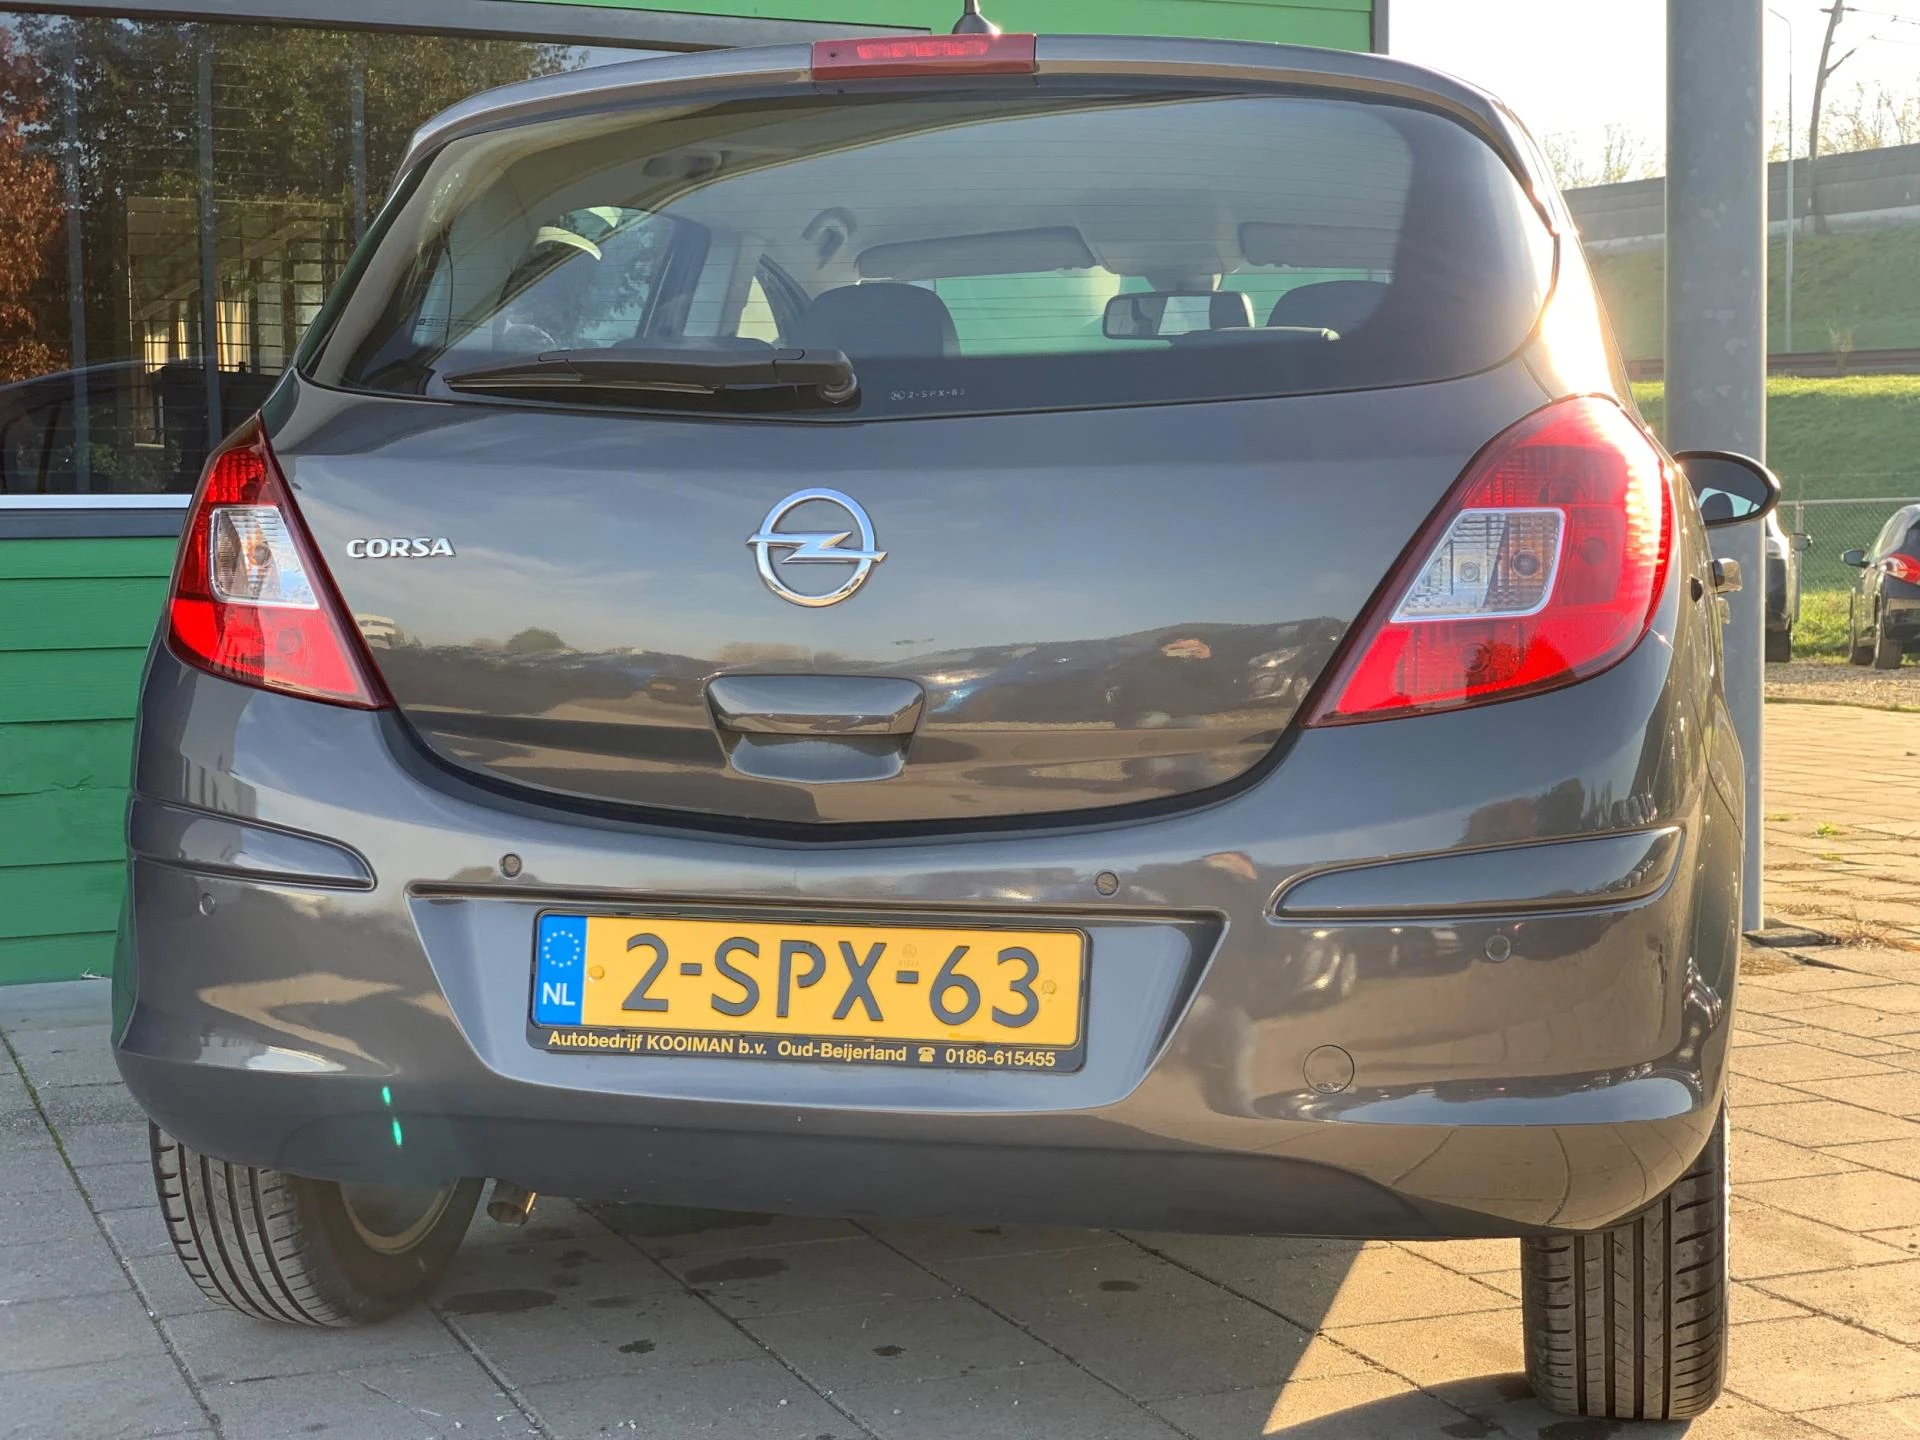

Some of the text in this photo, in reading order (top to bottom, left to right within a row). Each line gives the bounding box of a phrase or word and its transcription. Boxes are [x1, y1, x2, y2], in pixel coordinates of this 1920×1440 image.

[346, 537, 455, 558] CORSA
[542, 932, 1040, 1029] NL 2-SPX-63
[548, 1030, 1056, 1067] Autobedrijf KOOIMAN b.v. Oud-Beijerland 0186-615455
